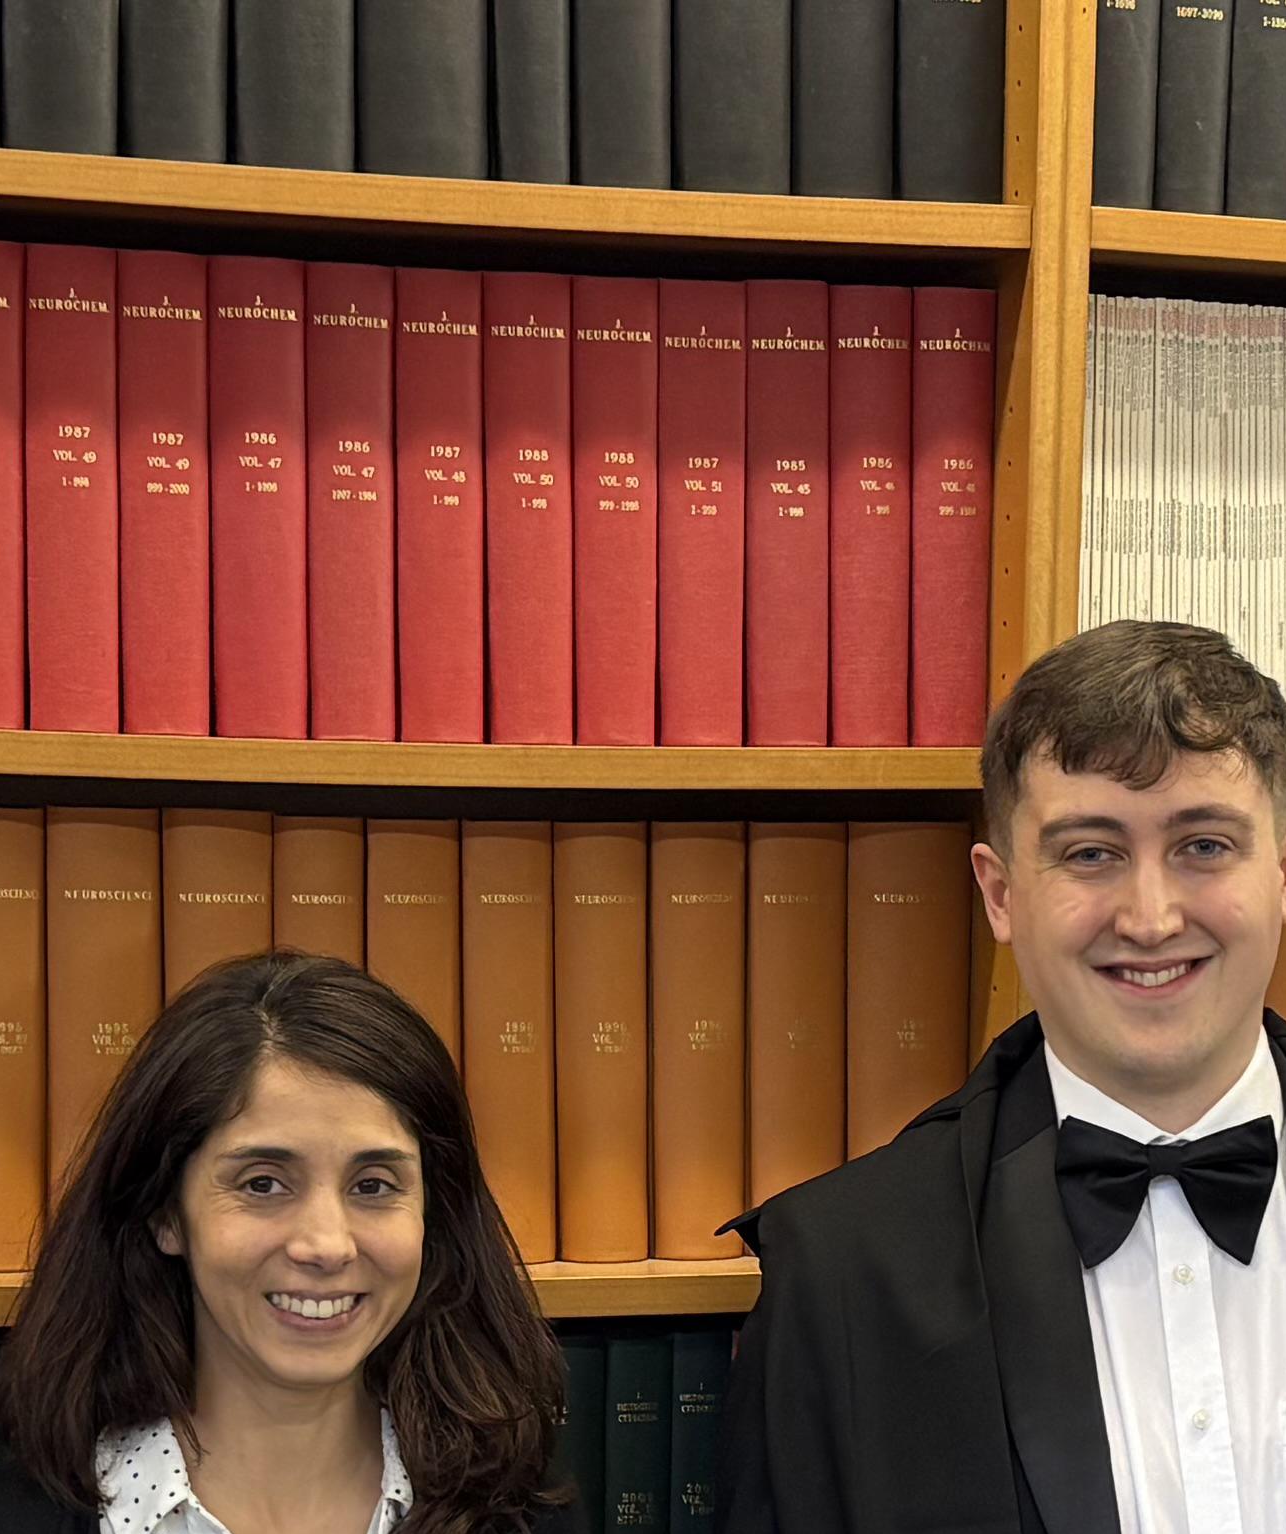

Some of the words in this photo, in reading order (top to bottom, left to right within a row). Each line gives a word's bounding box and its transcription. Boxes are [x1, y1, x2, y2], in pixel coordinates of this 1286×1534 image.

[59, 426, 90, 438] 1987
[153, 433, 183, 445] 1987
[245, 433, 276, 444] 1986
[339, 441, 370, 453] 1986
[431, 446, 460, 458] 1987
[83, 452, 96, 463] 49
[520, 449, 548, 461] 1988
[605, 452, 634, 464] 1988
[176, 458, 189, 469] 49
[269, 457, 281, 468] 47
[689, 457, 718, 468] 1987
[777, 460, 805, 471] 1985
[863, 457, 892, 468] 1986
[944, 459, 972, 469] 1986
[362, 467, 374, 477] 47
[540, 474, 553, 485] 50
[626, 477, 638, 487] 50
[712, 481, 721, 492] 51
